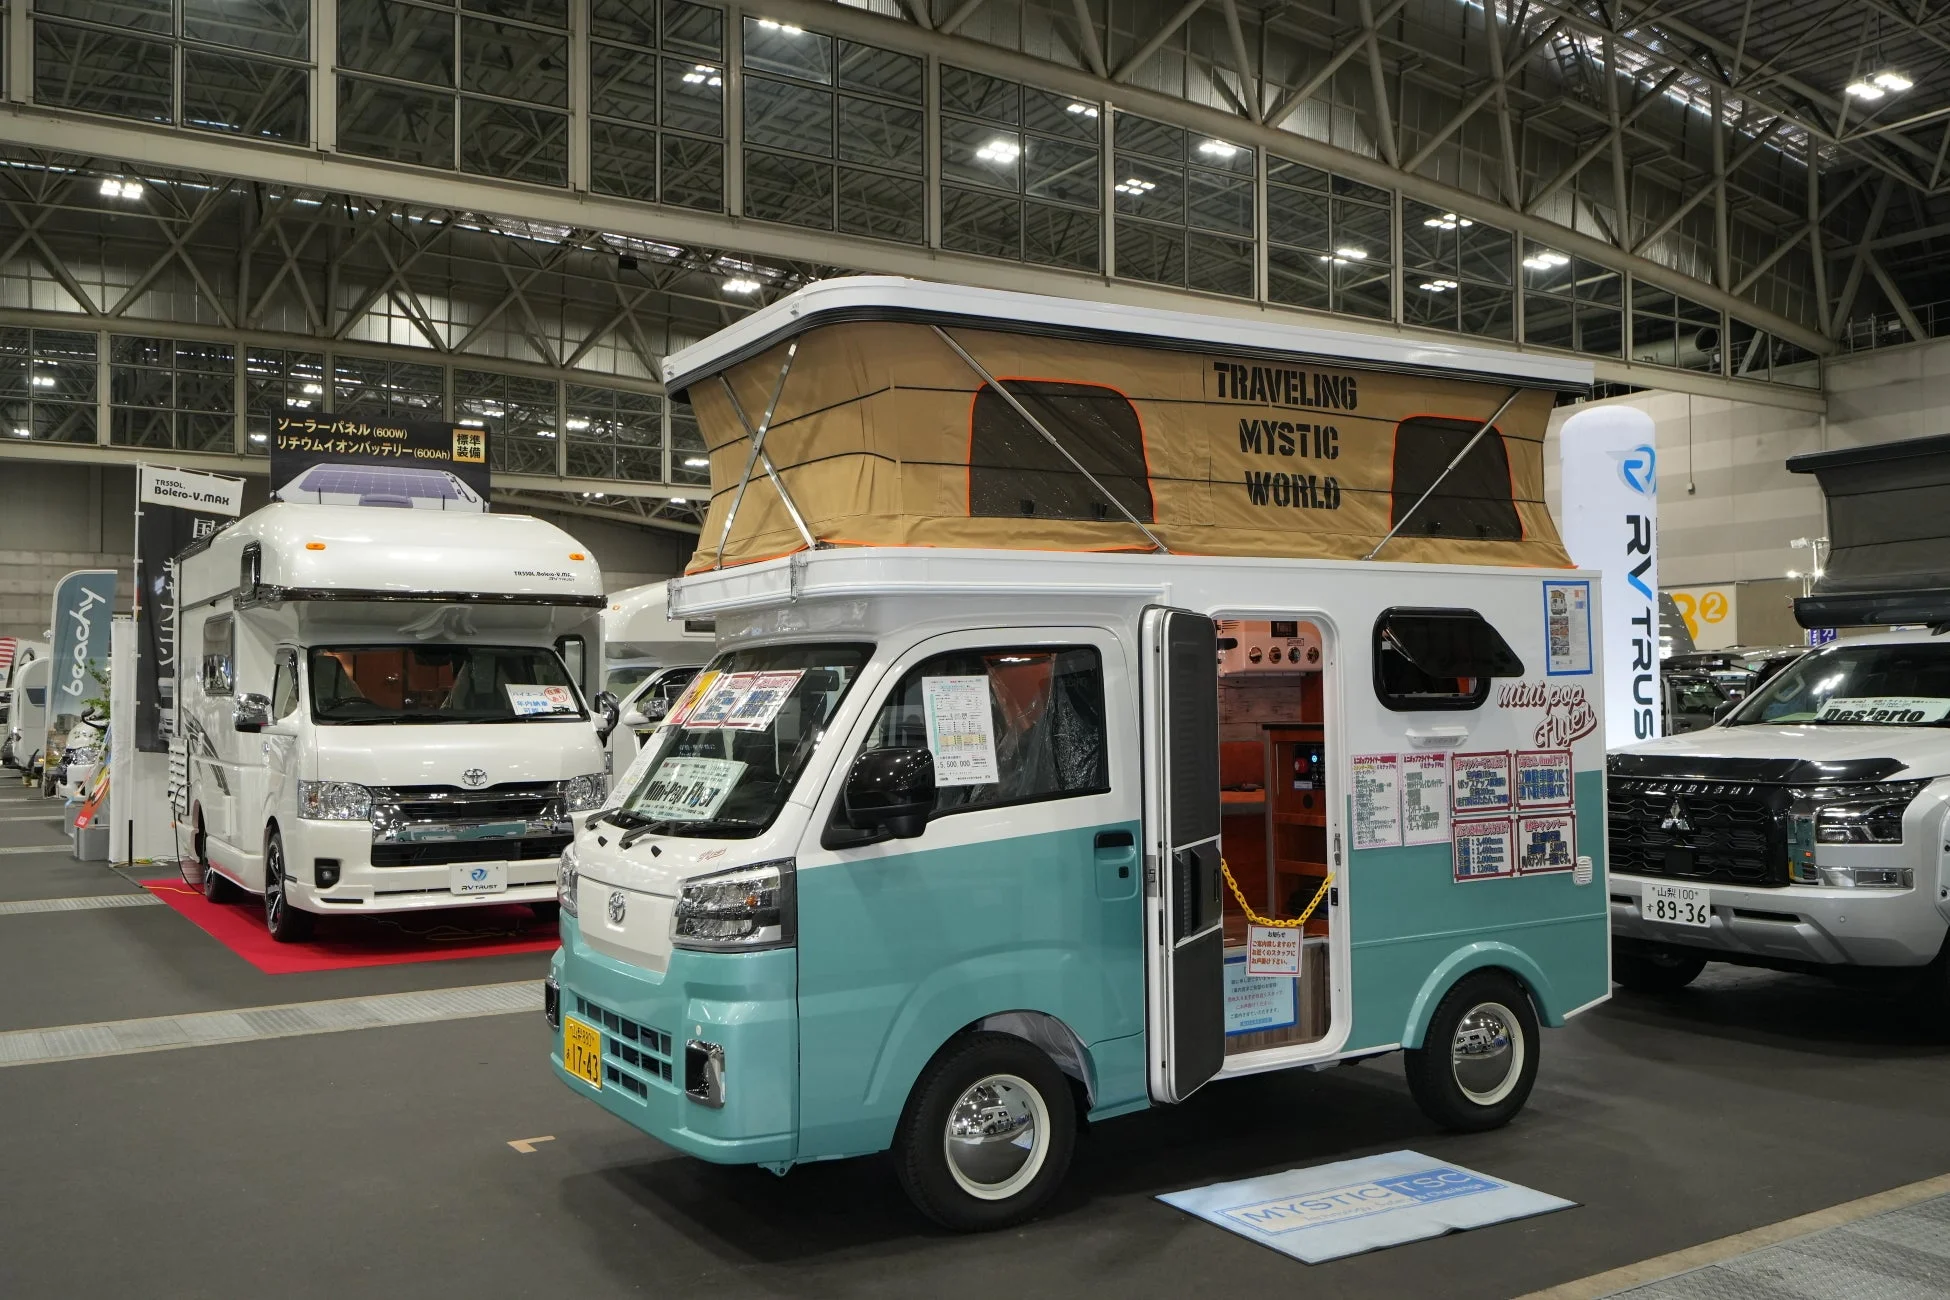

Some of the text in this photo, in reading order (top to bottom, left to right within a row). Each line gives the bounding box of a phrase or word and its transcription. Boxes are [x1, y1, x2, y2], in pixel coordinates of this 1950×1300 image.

[1213, 361, 1358, 411] TRAVELING
[277, 417, 371, 436] ソーラーパネル
[1238, 418, 1339, 460] MYSTIC
[154, 486, 230, 506] Bolero-V.MAX
[1244, 470, 1341, 510] WORLD
[61, 586, 107, 697] beachy
[1626, 514, 1654, 741] RV TRUS
[1496, 680, 1586, 716] mini pop
[1656, 899, 1707, 924] 89-36
[572, 1043, 599, 1083] 17-43
[1241, 1170, 1473, 1223] MYSTIC TSC
